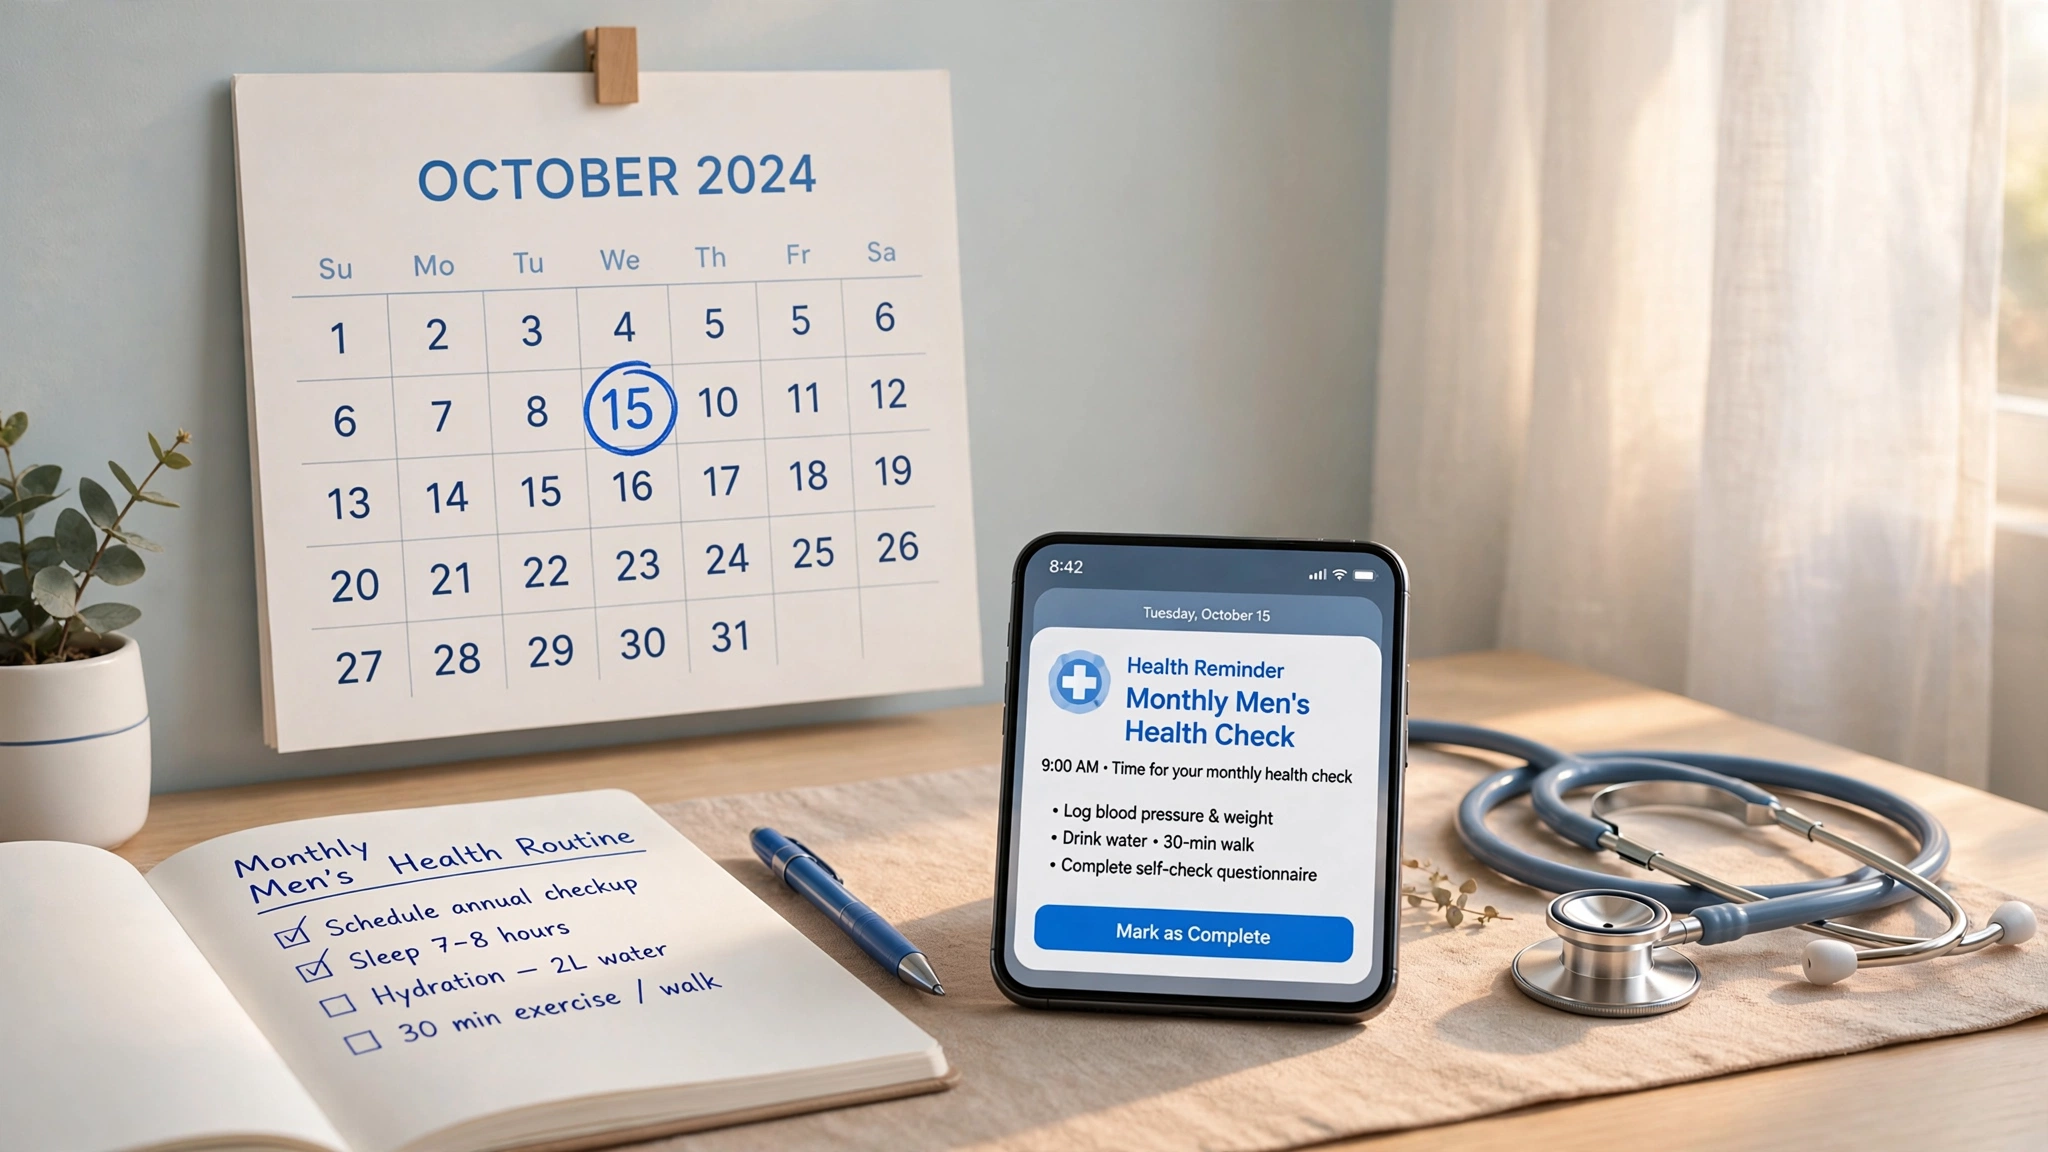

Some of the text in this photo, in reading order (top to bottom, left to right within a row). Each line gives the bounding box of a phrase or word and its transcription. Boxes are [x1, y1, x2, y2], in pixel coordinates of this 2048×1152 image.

[418, 153, 817, 202] OCTOBER 2024
[319, 241, 896, 280] Su Mo Tu We Th Fr Sa
[331, 301, 895, 355] 1 2 3 4 5 5 6
[334, 378, 907, 438] 6 7 8 15 10 11 12
[327, 454, 912, 520] 13 14 15 16 17 18 19
[331, 530, 919, 603] 20 21 22 23 24 25 26
[1049, 559, 1083, 574] 8:42
[1143, 606, 1271, 623] Tuesday, October 15
[336, 619, 748, 685] 27 28 29 30 31
[1127, 656, 1285, 679] Health Reminder
[1126, 686, 1310, 718] Monthly Men's
[1125, 719, 1296, 748] Health Check
[1041, 757, 1353, 784] 9:00 AM Time for your monthly health check
[1064, 803, 1274, 829] Log blood pressure & weight
[234, 838, 367, 879] Monthly
[1063, 829, 1255, 852] Drink water 30-min walk
[249, 831, 635, 904] Men's Health Routine
[1061, 857, 1318, 883] Complete self-check questionnaire
[325, 878, 638, 937] Schedule annual checkup
[349, 947, 420, 970] Sleep
[496, 923, 570, 943] hours
[1116, 922, 1271, 948] Mark as Complete
[371, 971, 506, 1009] Hydration
[550, 954, 588, 974] 2L
[597, 944, 667, 966] water
[398, 1020, 438, 1043] 30
[451, 1011, 502, 1032] min
[514, 992, 622, 1020] exercise
[658, 971, 723, 996] walk
